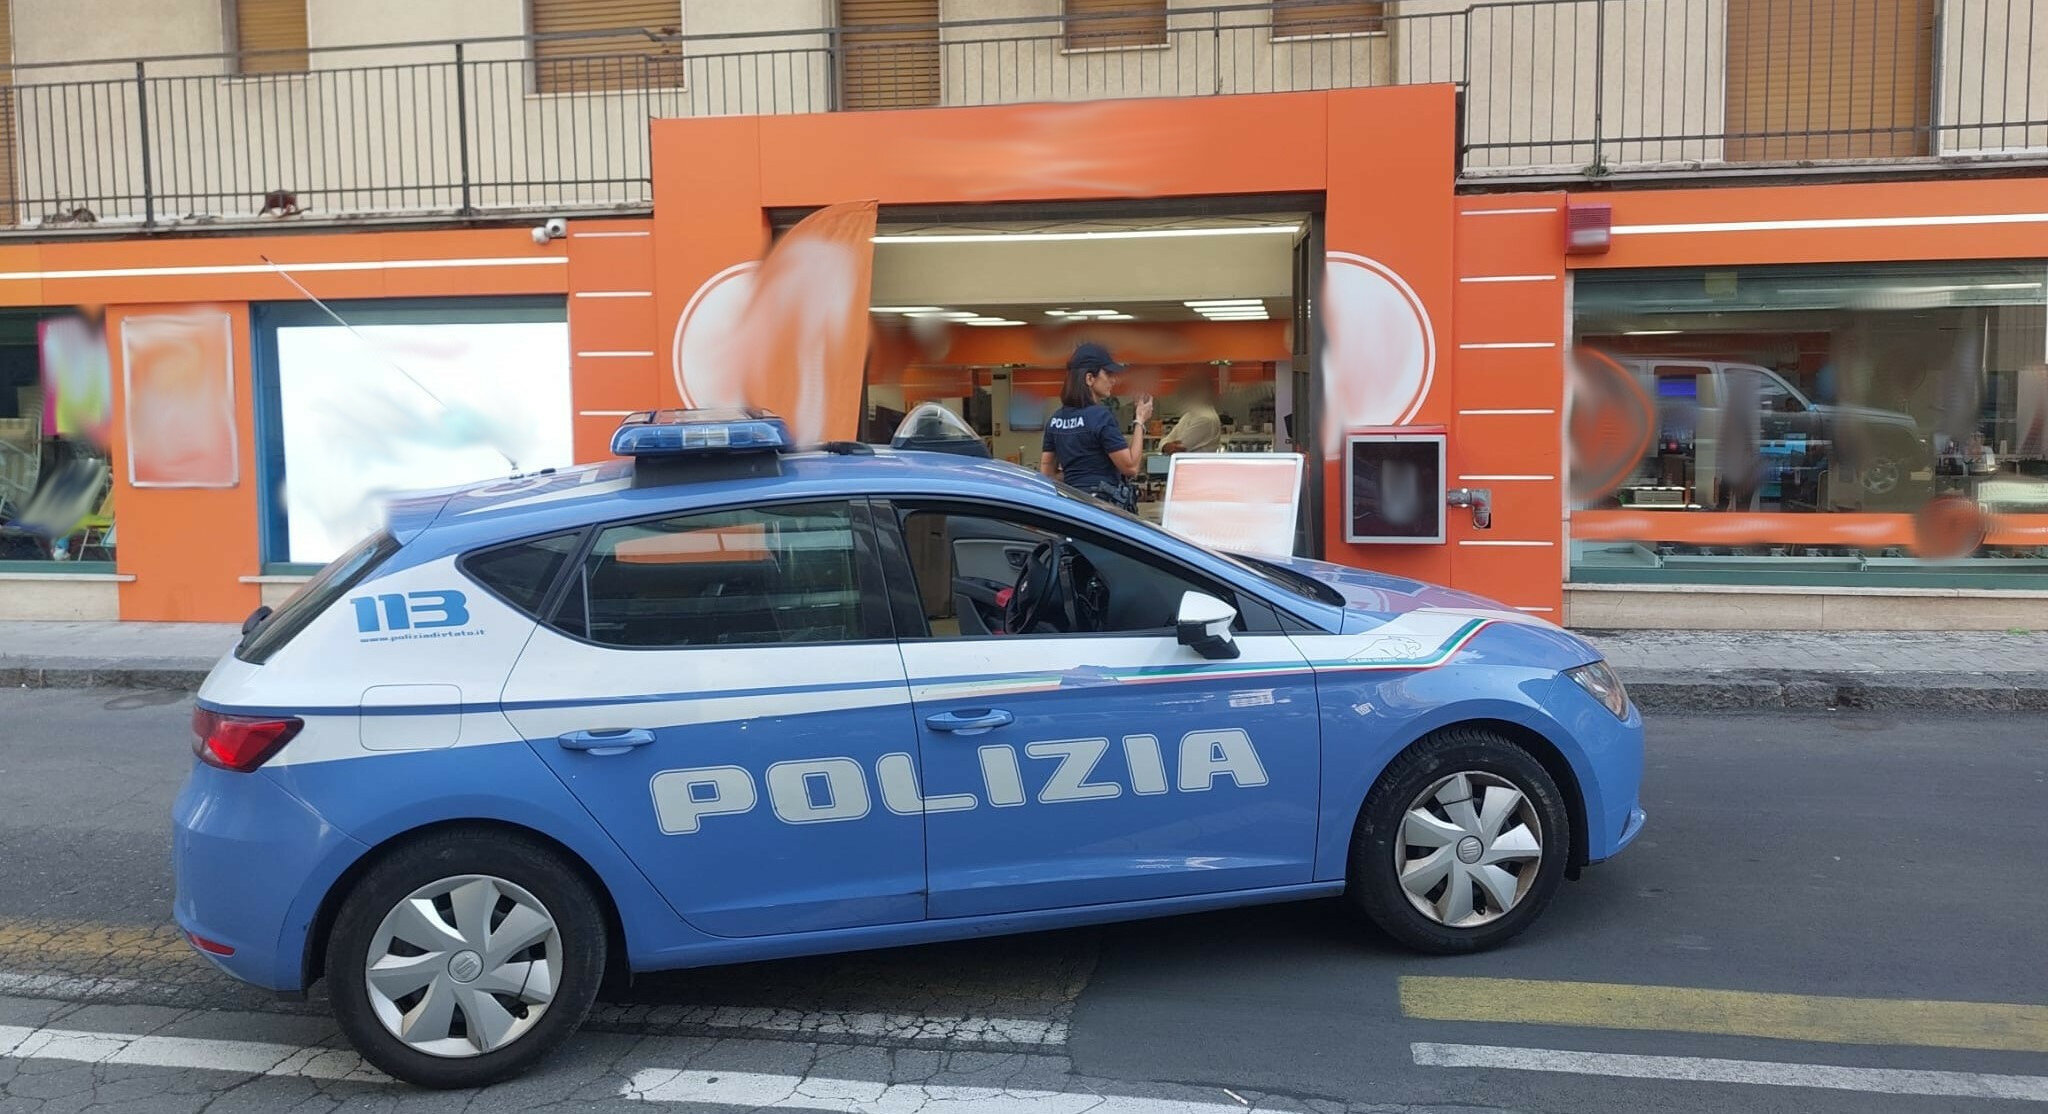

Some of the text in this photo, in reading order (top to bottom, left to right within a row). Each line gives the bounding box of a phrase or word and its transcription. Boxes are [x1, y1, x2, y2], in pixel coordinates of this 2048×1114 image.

[1050, 416, 1085, 430] POLIZIA
[350, 589, 470, 633] 113
[649, 727, 1270, 836] POLIZIA
